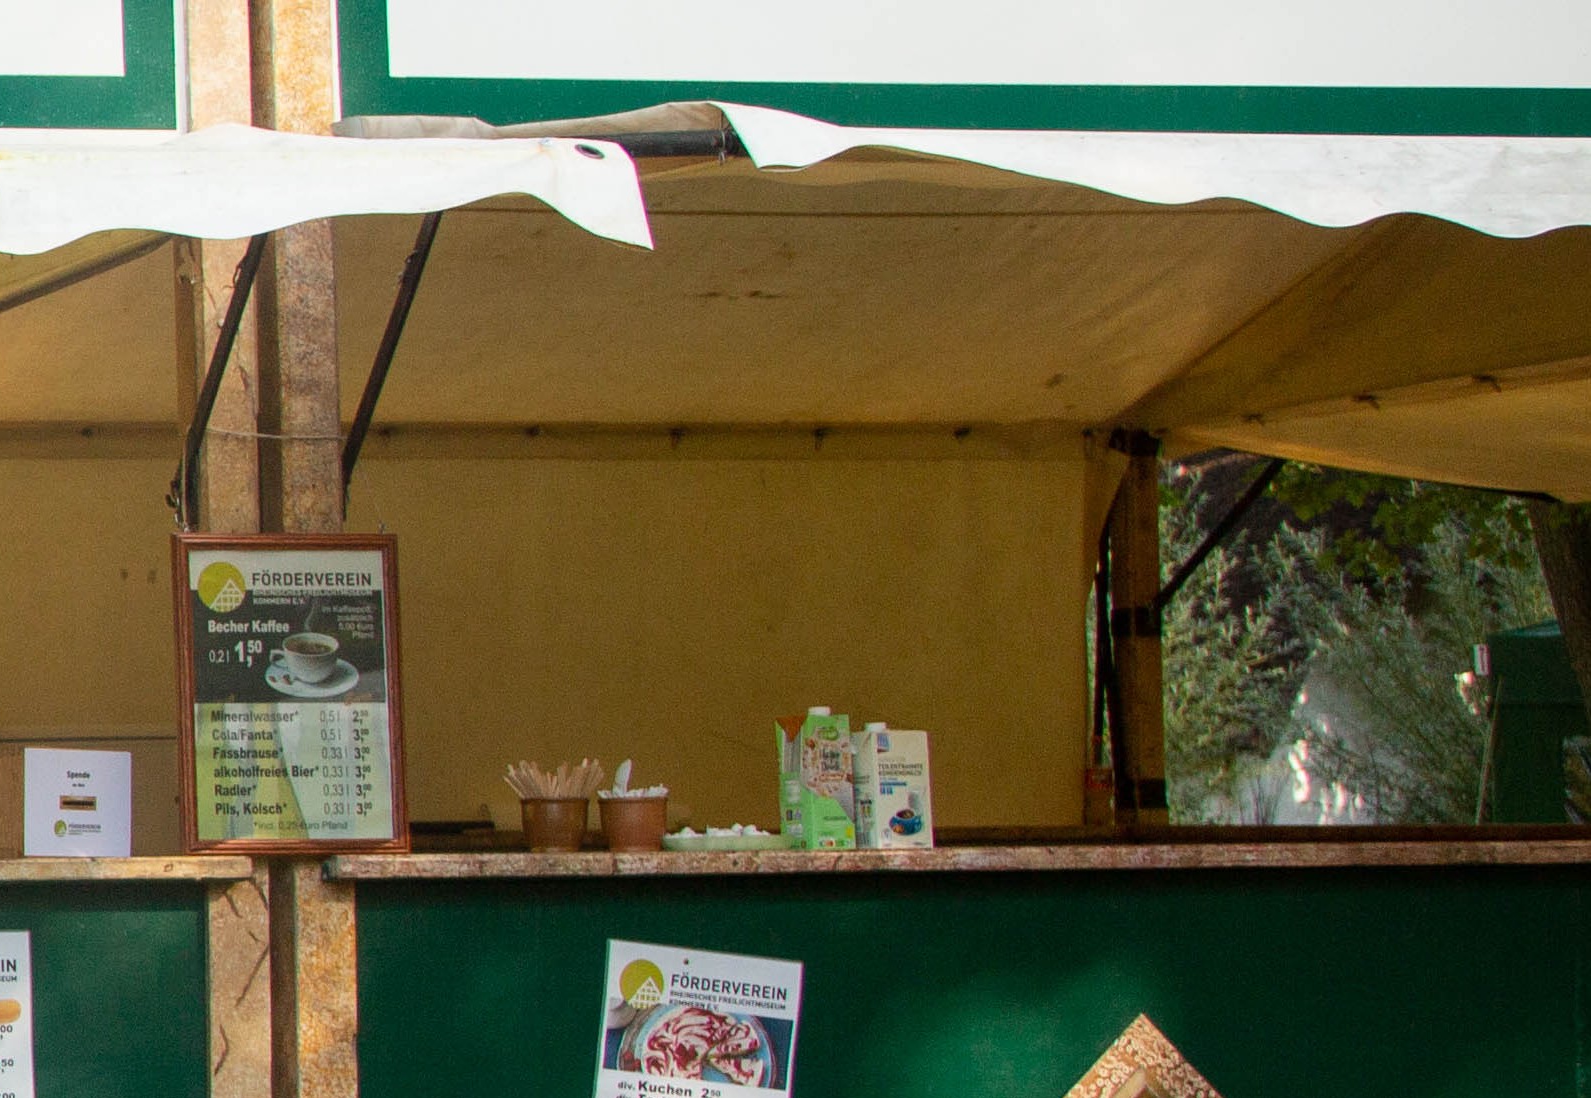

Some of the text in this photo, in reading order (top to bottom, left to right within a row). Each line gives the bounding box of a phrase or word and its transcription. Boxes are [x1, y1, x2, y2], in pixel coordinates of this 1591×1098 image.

[252, 569, 372, 586] FÖRDERVEREIN
[208, 620, 290, 633] Becher Kaffee
[234, 640, 263, 668] 1,50
[67, 771, 90, 779] Spende
[213, 765, 289, 777] alkoholfreies
[215, 803, 240, 816] Pils,
[671, 972, 787, 1001] FÖRDERVEREIN
[718, 995, 786, 1010] FREILICHTMUSEUM
[618, 1081, 636, 1091] div.
[638, 1081, 692, 1097] Kuchen
